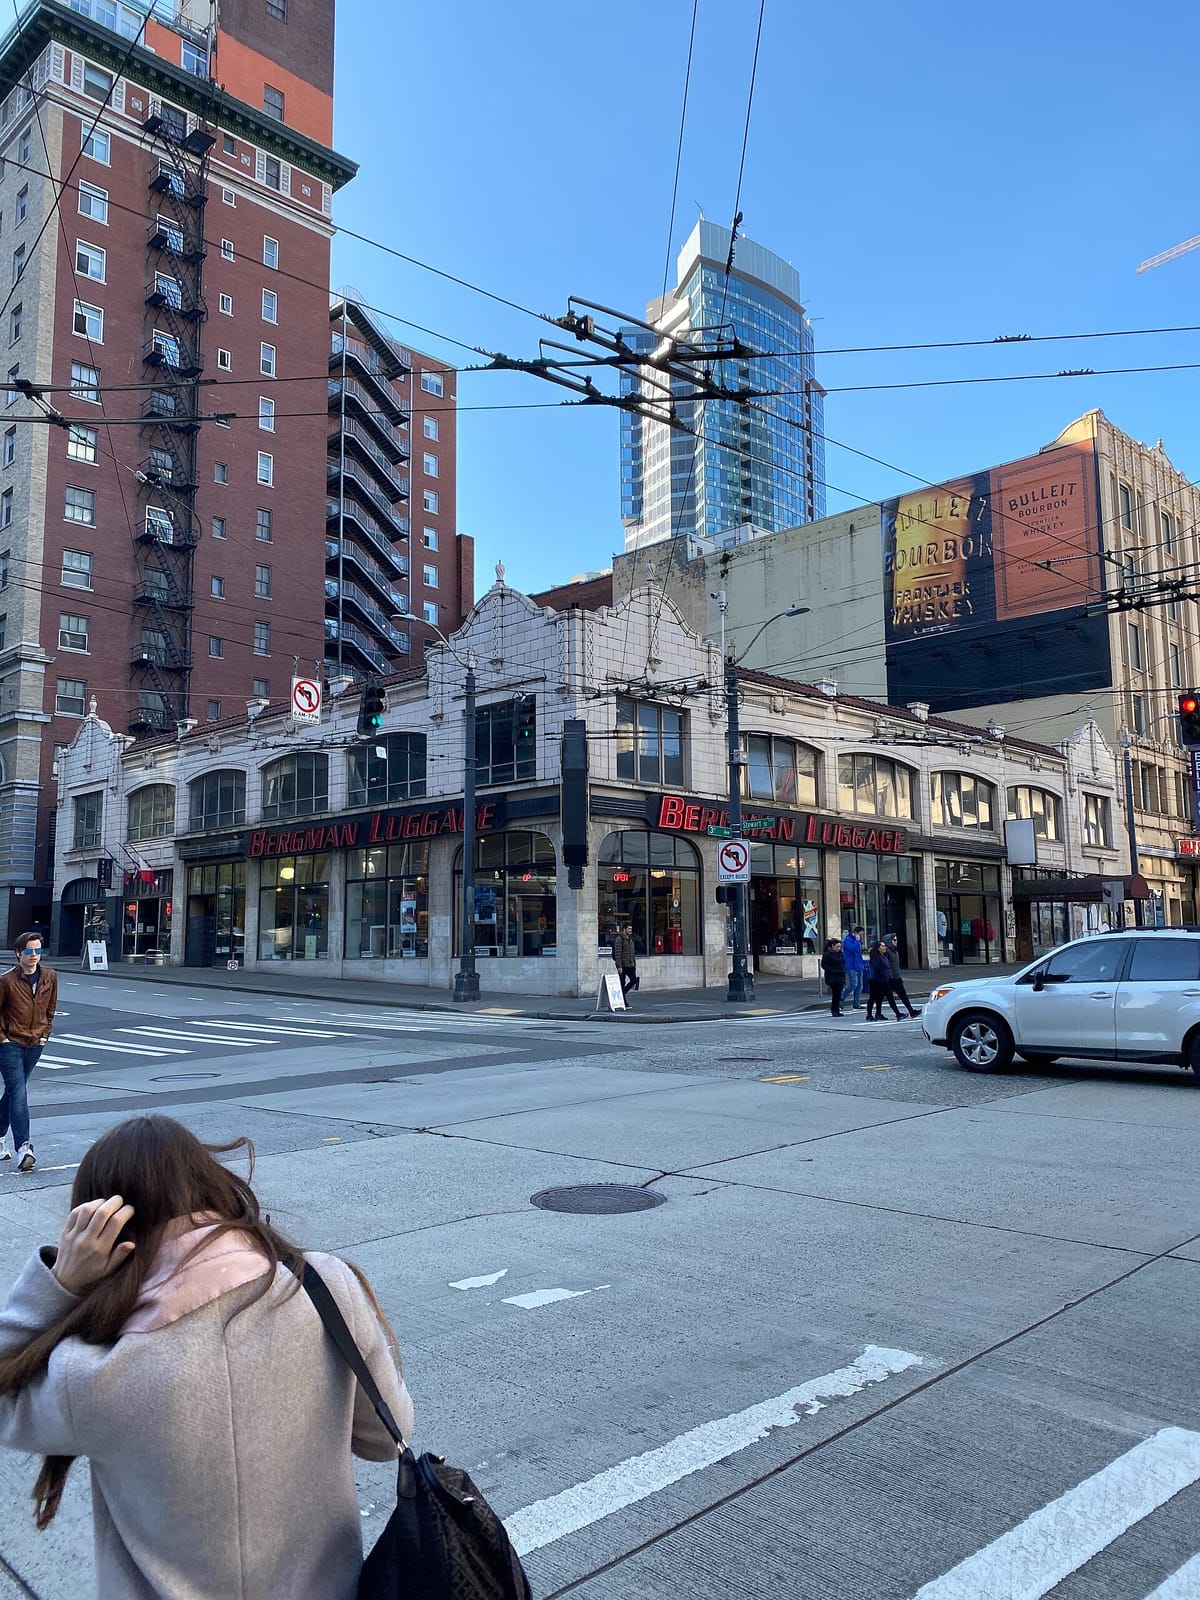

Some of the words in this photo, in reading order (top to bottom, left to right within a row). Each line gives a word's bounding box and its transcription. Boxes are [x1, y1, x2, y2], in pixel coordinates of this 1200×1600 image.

[1008, 483, 1077, 511] BULLEIT
[1018, 499, 1068, 518] BOURBON
[890, 600, 974, 626] WHISKEY
[742, 820, 762, 829] Stewart
[806, 815, 907, 852] LUGGAGE
[248, 821, 359, 858] BERGMAN
[613, 873, 629, 882] OPEN
